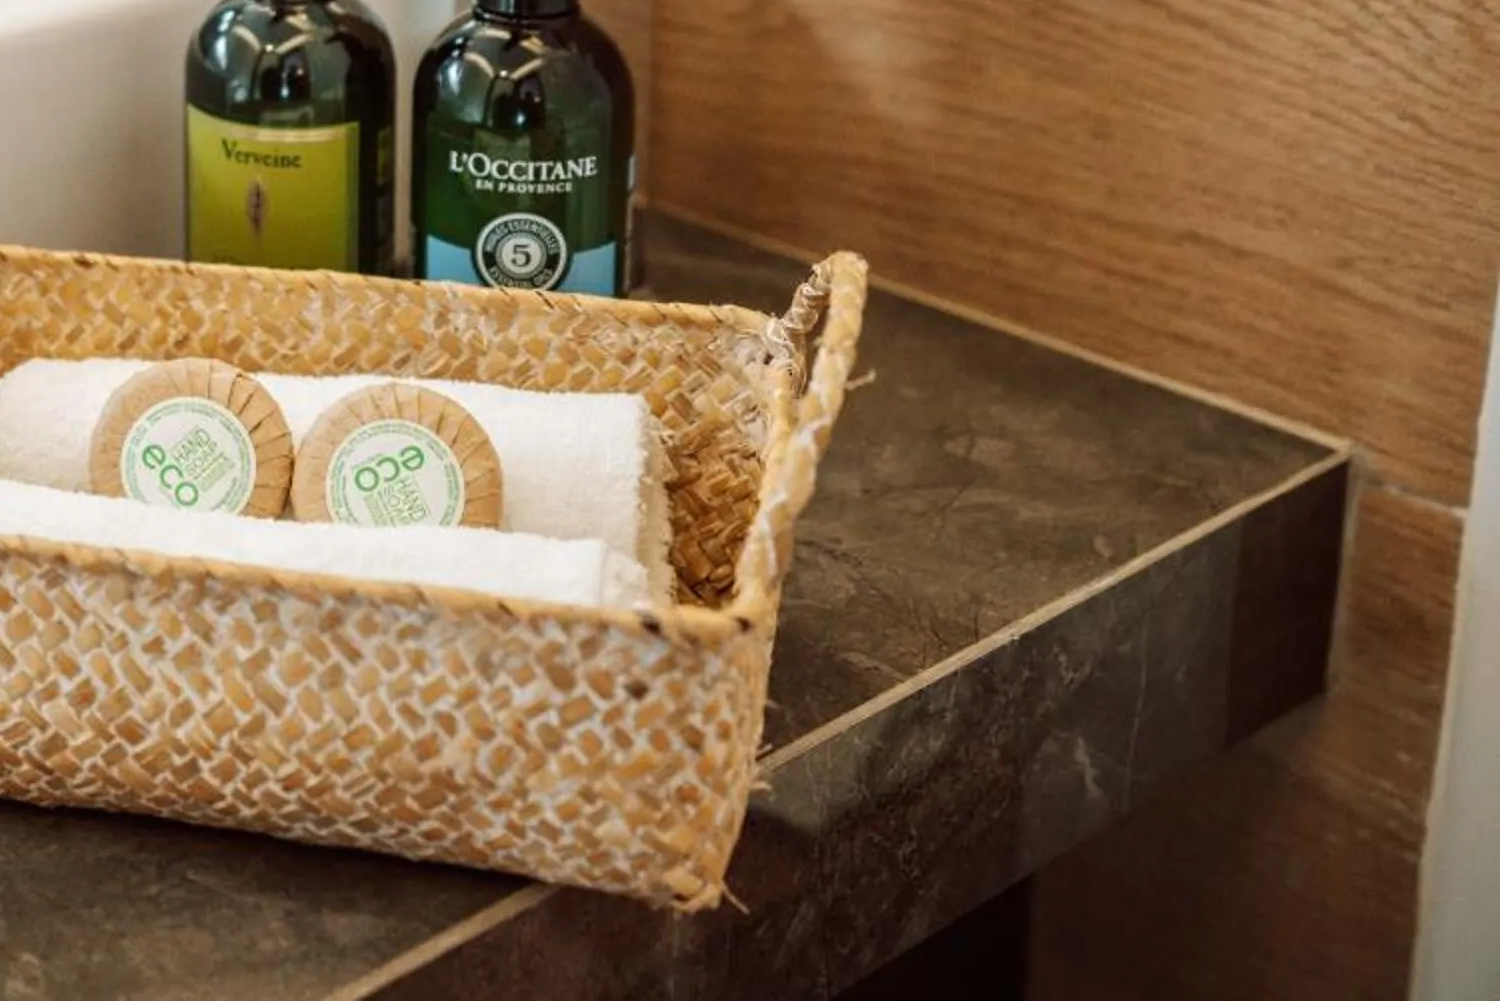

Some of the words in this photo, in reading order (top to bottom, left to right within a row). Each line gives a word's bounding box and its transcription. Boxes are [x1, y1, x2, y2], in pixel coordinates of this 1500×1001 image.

[221, 138, 303, 169] Verveine
[450, 150, 598, 182] L'OCCITANE
[475, 179, 494, 191] EN
[500, 181, 573, 194] PROVENCE
[510, 244, 532, 267] 5
[142, 444, 199, 506] eco
[354, 445, 424, 492] eco
